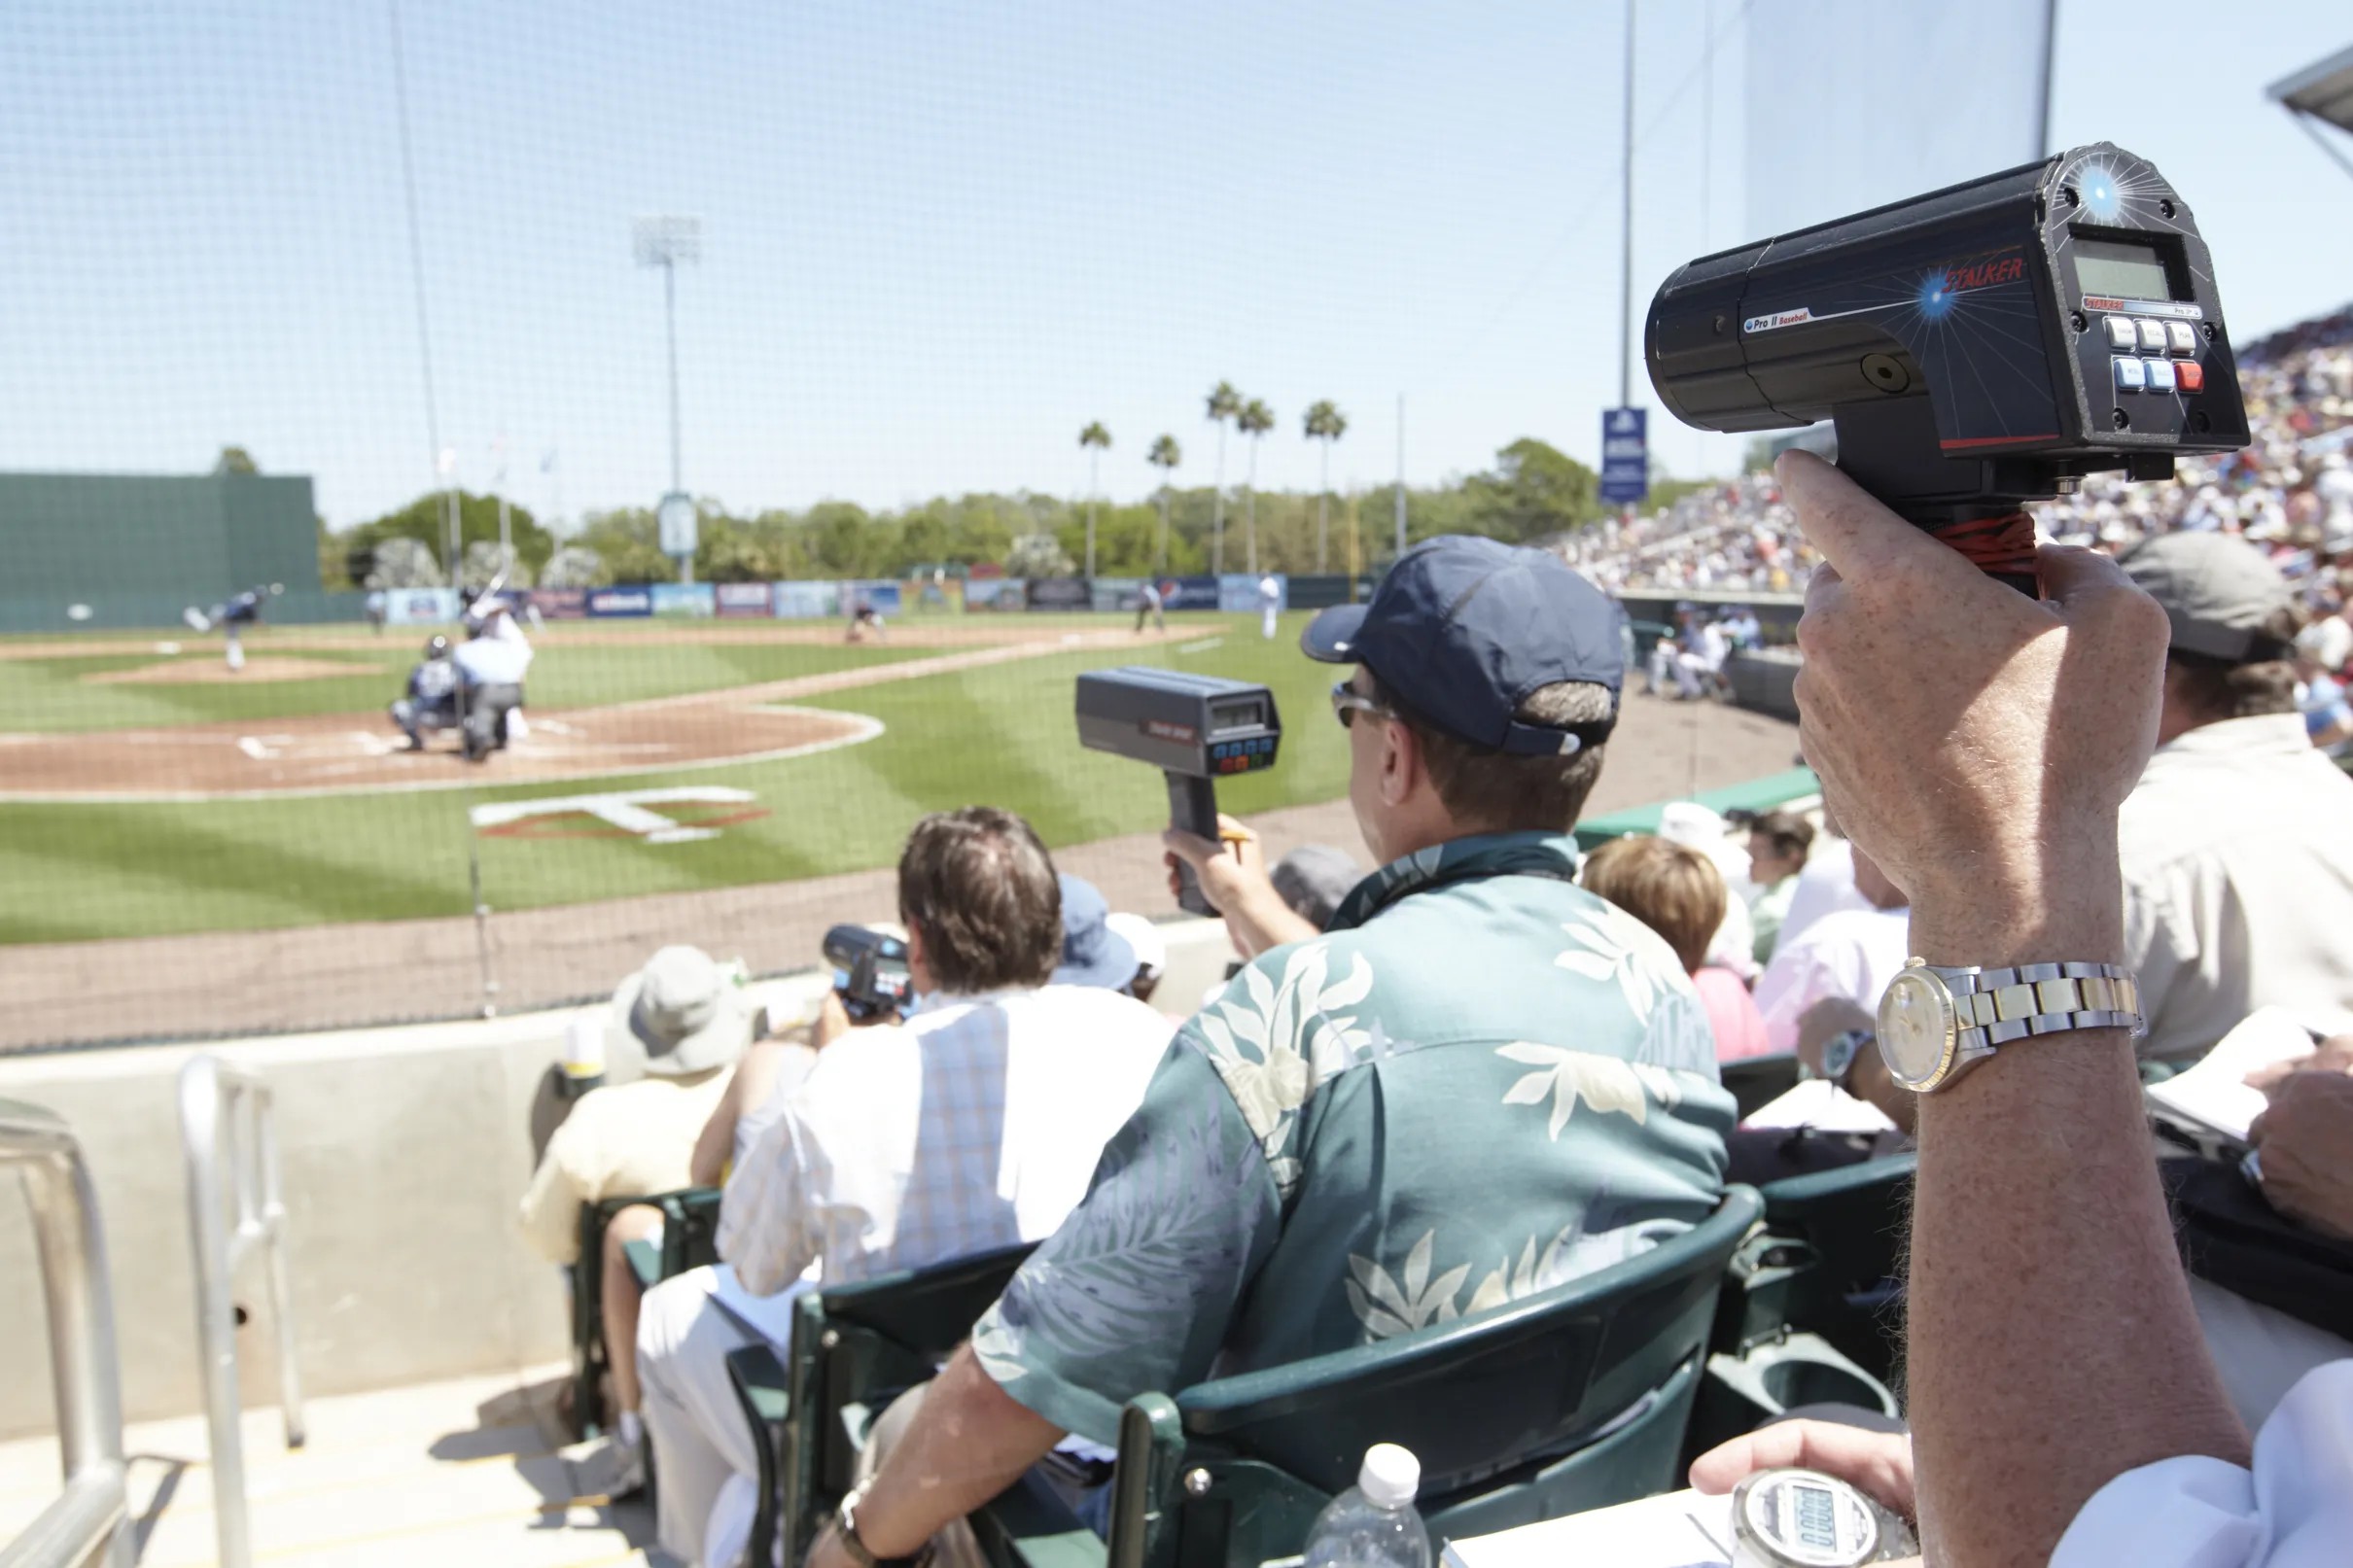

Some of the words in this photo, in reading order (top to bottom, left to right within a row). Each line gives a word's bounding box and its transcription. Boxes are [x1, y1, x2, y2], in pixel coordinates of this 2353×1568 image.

[1941, 257, 2022, 294] STALKER
[2086, 297, 2124, 310] STALKER
[1753, 319, 1768, 330] Pro
[1779, 312, 1809, 325] Baseball
